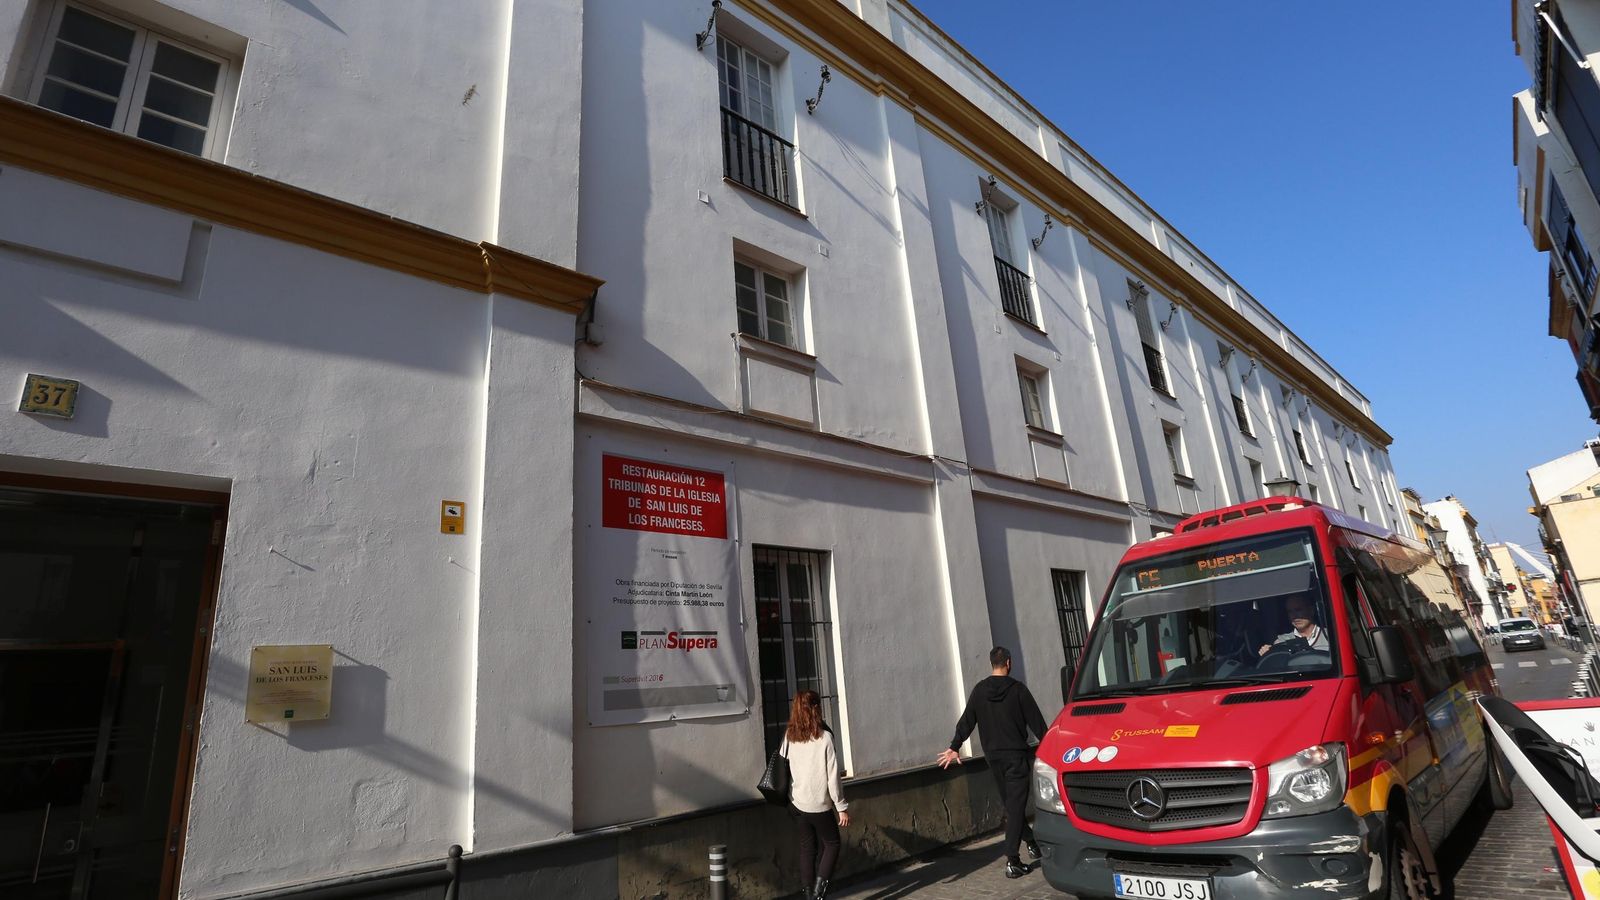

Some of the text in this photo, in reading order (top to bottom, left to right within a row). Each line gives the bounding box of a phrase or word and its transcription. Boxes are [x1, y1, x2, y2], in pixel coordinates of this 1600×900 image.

[33, 384, 66, 406] 37
[622, 464, 705, 487] RESTAURACIÓN 12
[608, 478, 720, 503] TRIBUNAS DE LA IGLESIA
[628, 496, 702, 516] DE SAN LUIS DE
[628, 513, 705, 532] LOS FRANCESES.
[1197, 551, 1260, 571] PUERTA
[269, 665, 318, 675] SAN LUIS
[285, 674, 329, 683] FRANCESES
[649, 674, 664, 682] 2016
[1123, 728, 1165, 737] TUSSAM
[1124, 878, 1207, 900] 2100 JSJ
